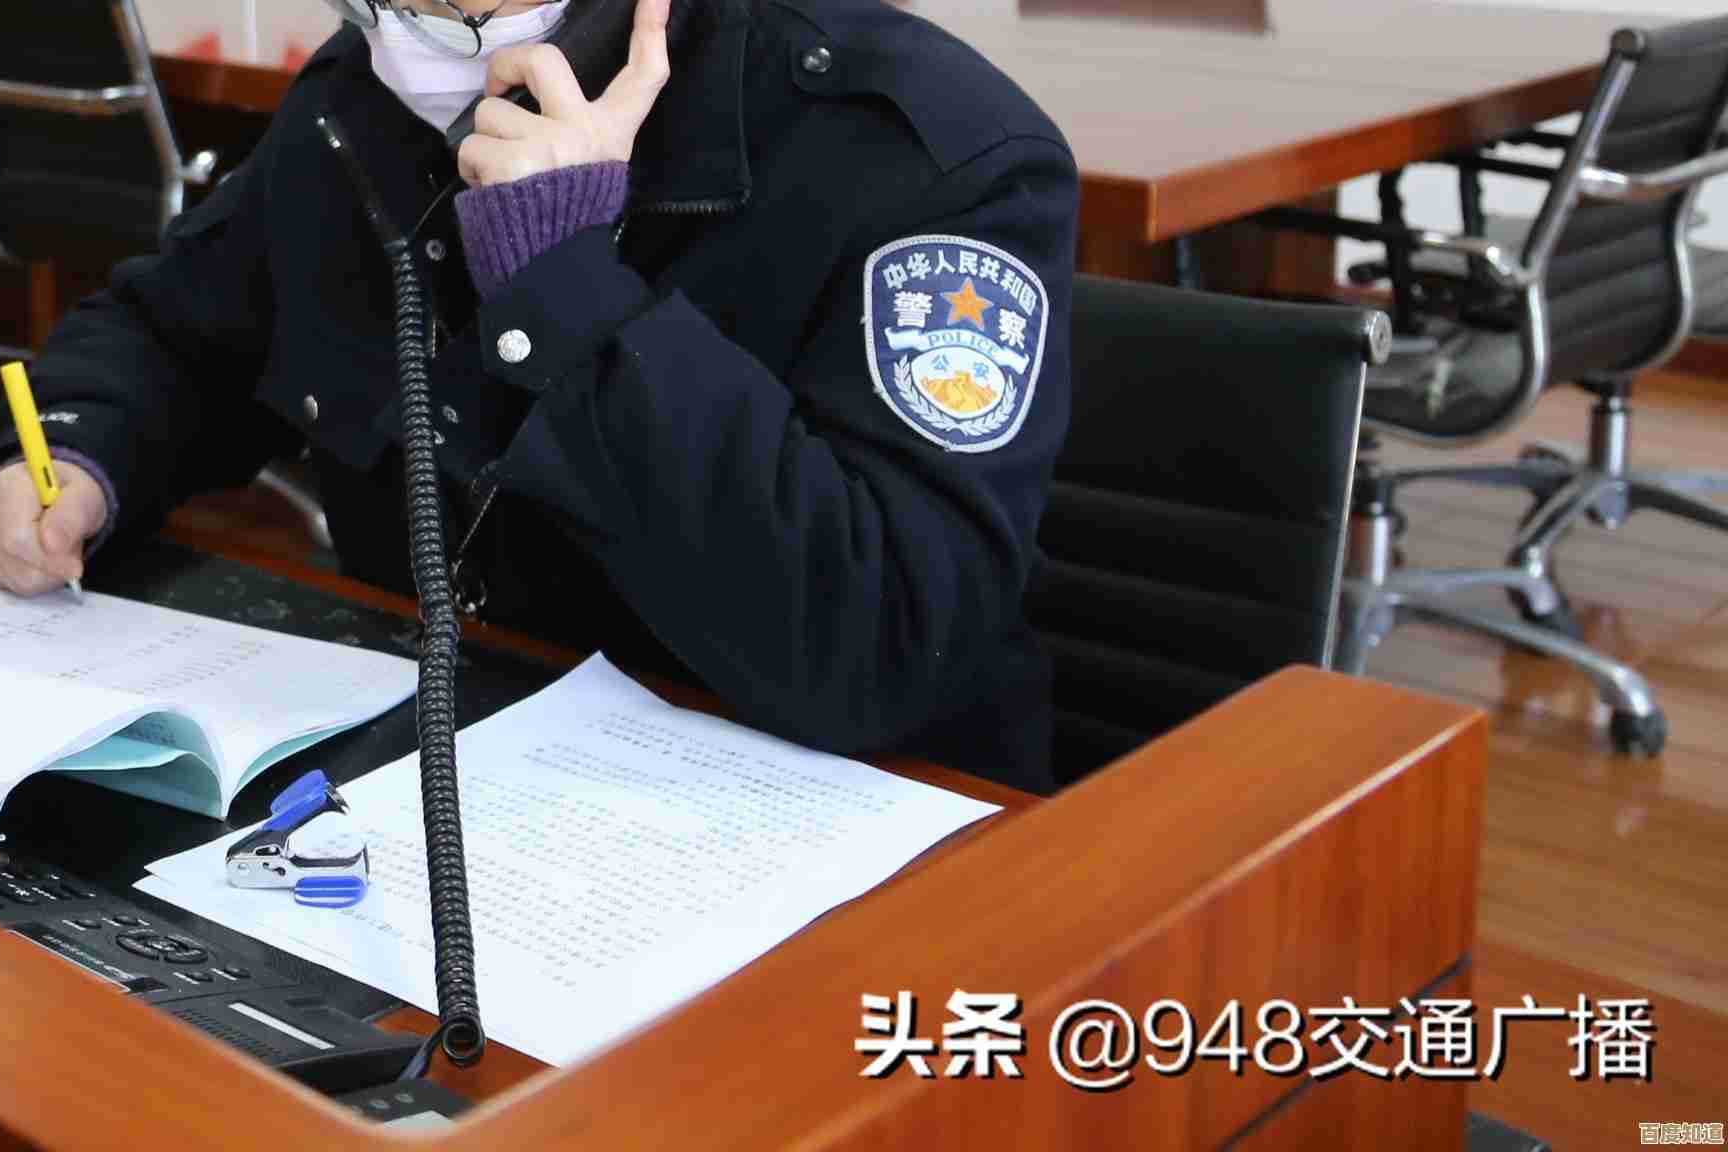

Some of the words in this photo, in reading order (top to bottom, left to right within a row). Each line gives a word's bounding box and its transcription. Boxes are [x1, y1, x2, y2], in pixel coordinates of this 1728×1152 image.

[882, 248, 1038, 316] 中华人民共和国
[927, 331, 1001, 355] POLICE
